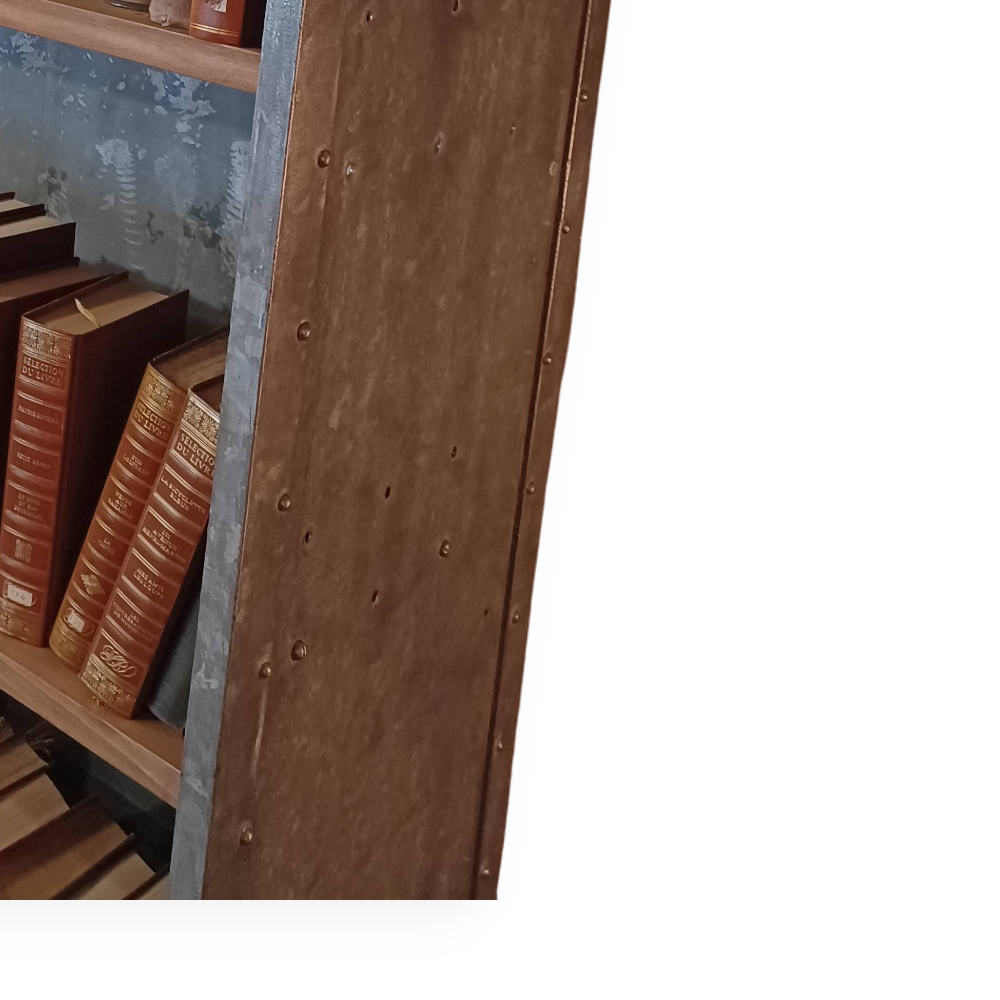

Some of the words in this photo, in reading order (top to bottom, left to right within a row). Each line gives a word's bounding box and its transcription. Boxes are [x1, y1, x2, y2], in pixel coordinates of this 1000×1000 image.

[22, 366, 34, 377] DU
[36, 371, 63, 387] LIVRE
[134, 410, 144, 423] DU
[144, 420, 170, 439] LIVRE
[177, 442, 189, 456] DU
[190, 454, 213, 477] LIVR
[181, 433, 214, 466] SÉLECTIO
